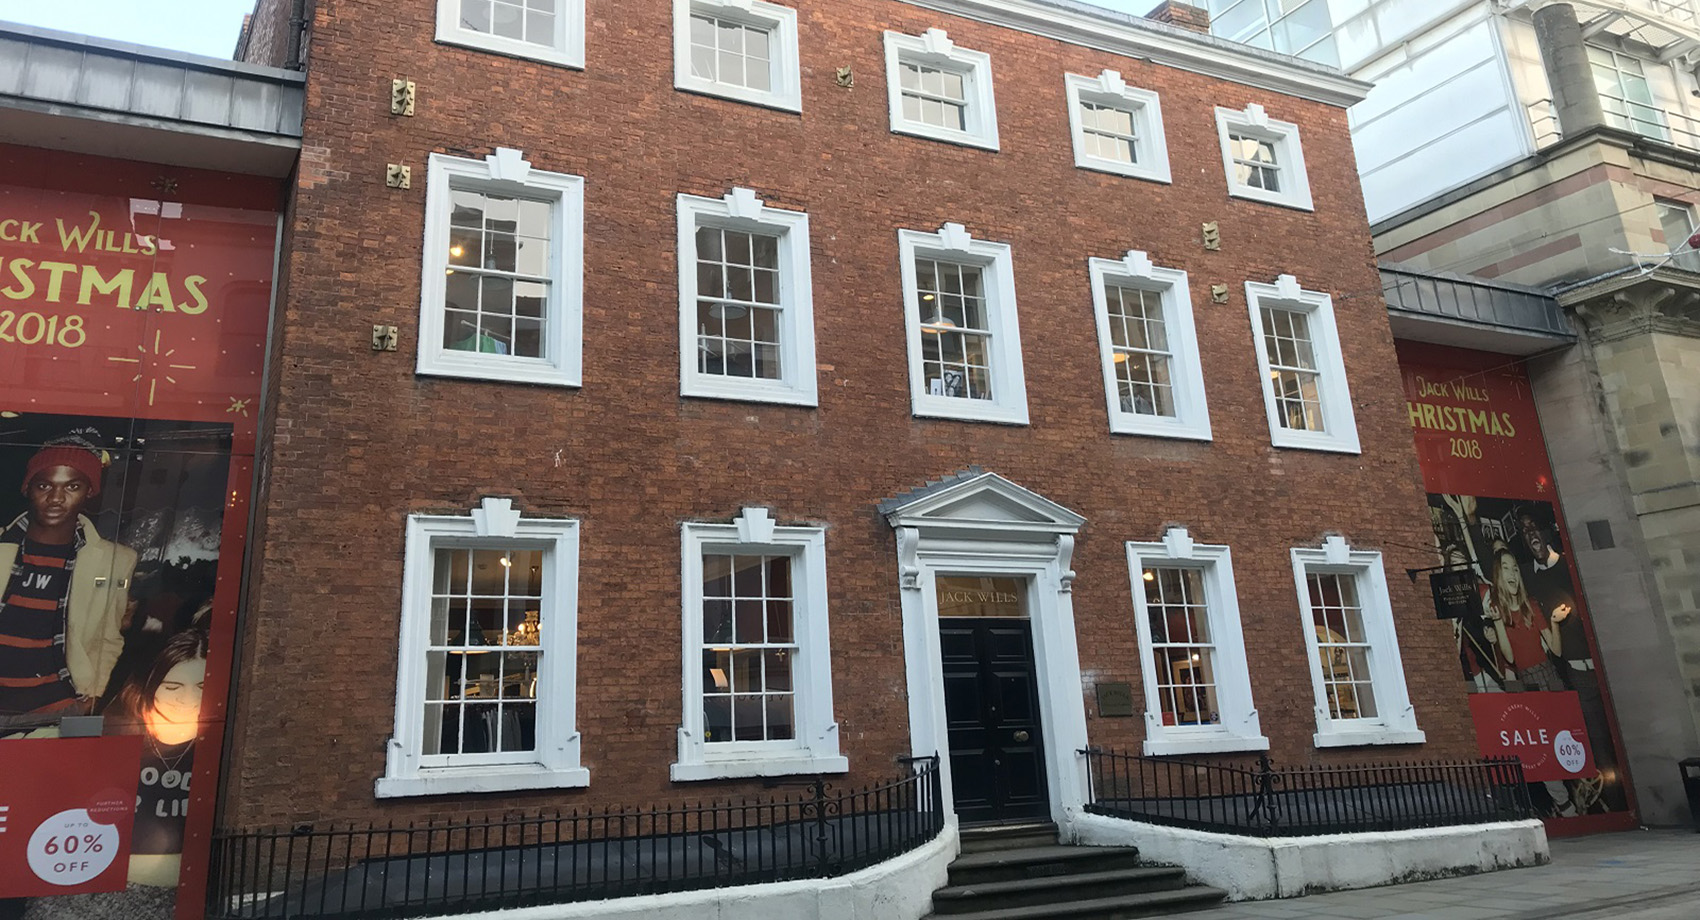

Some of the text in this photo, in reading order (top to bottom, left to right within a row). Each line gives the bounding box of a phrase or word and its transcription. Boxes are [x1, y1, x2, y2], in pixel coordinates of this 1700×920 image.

[55, 211, 157, 256] WILLS
[0, 257, 209, 315] STMAS
[0, 311, 87, 348] 2018
[1415, 375, 1490, 402] JACK WILLS
[1407, 401, 1516, 438] HRISTMAS
[1450, 437, 1483, 460] 2018
[940, 591, 1018, 604] JACK WILLS
[1500, 729, 1549, 747] SALE
[1560, 744, 1581, 756] 60%
[1566, 759, 1579, 767] OFF
[44, 833, 103, 856] 60%
[53, 861, 89, 873] OFF
